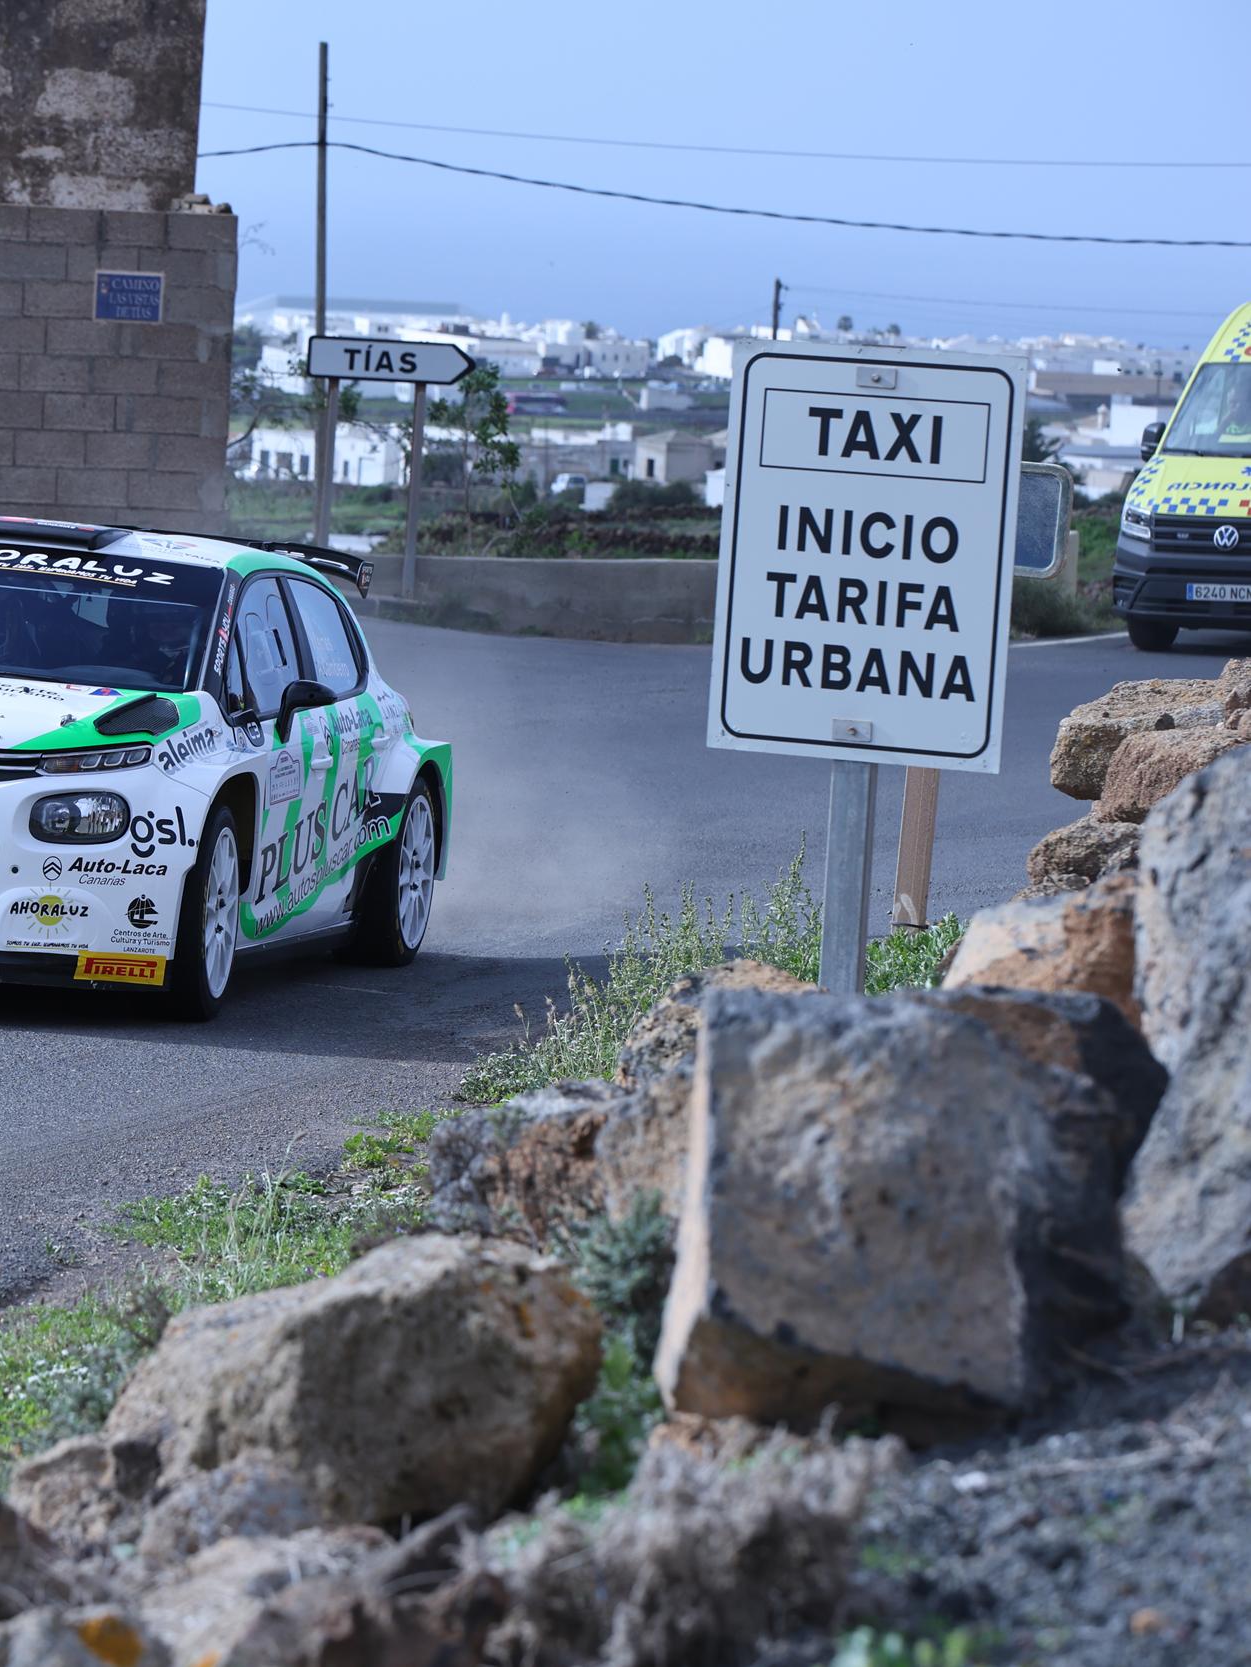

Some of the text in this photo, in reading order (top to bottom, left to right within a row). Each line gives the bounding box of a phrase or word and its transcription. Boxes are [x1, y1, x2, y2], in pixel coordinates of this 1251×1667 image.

[111, 279, 160, 291] CAMINO
[343, 344, 417, 374] TÍAS
[808, 406, 944, 465] TAXI
[776, 504, 959, 564] INICIO
[766, 571, 959, 633] TARIFA
[1195, 586, 1226, 599] 6240
[740, 636, 976, 703] URBANA
[330, 707, 374, 736] Auto-Laca
[255, 755, 381, 906] PLUS CAR
[68, 856, 169, 876] Auto-Laca
[254, 815, 391, 937] www.autospluscar.com
[78, 873, 127, 887] Canarias
[10, 901, 89, 918] AHORALUZ
[110, 935, 137, 944] Cultura
[143, 938, 170, 947] Turismo
[113, 928, 141, 938] Centros
[123, 946, 156, 954] LANZAROTE
[83, 957, 158, 979] PIRELLI
